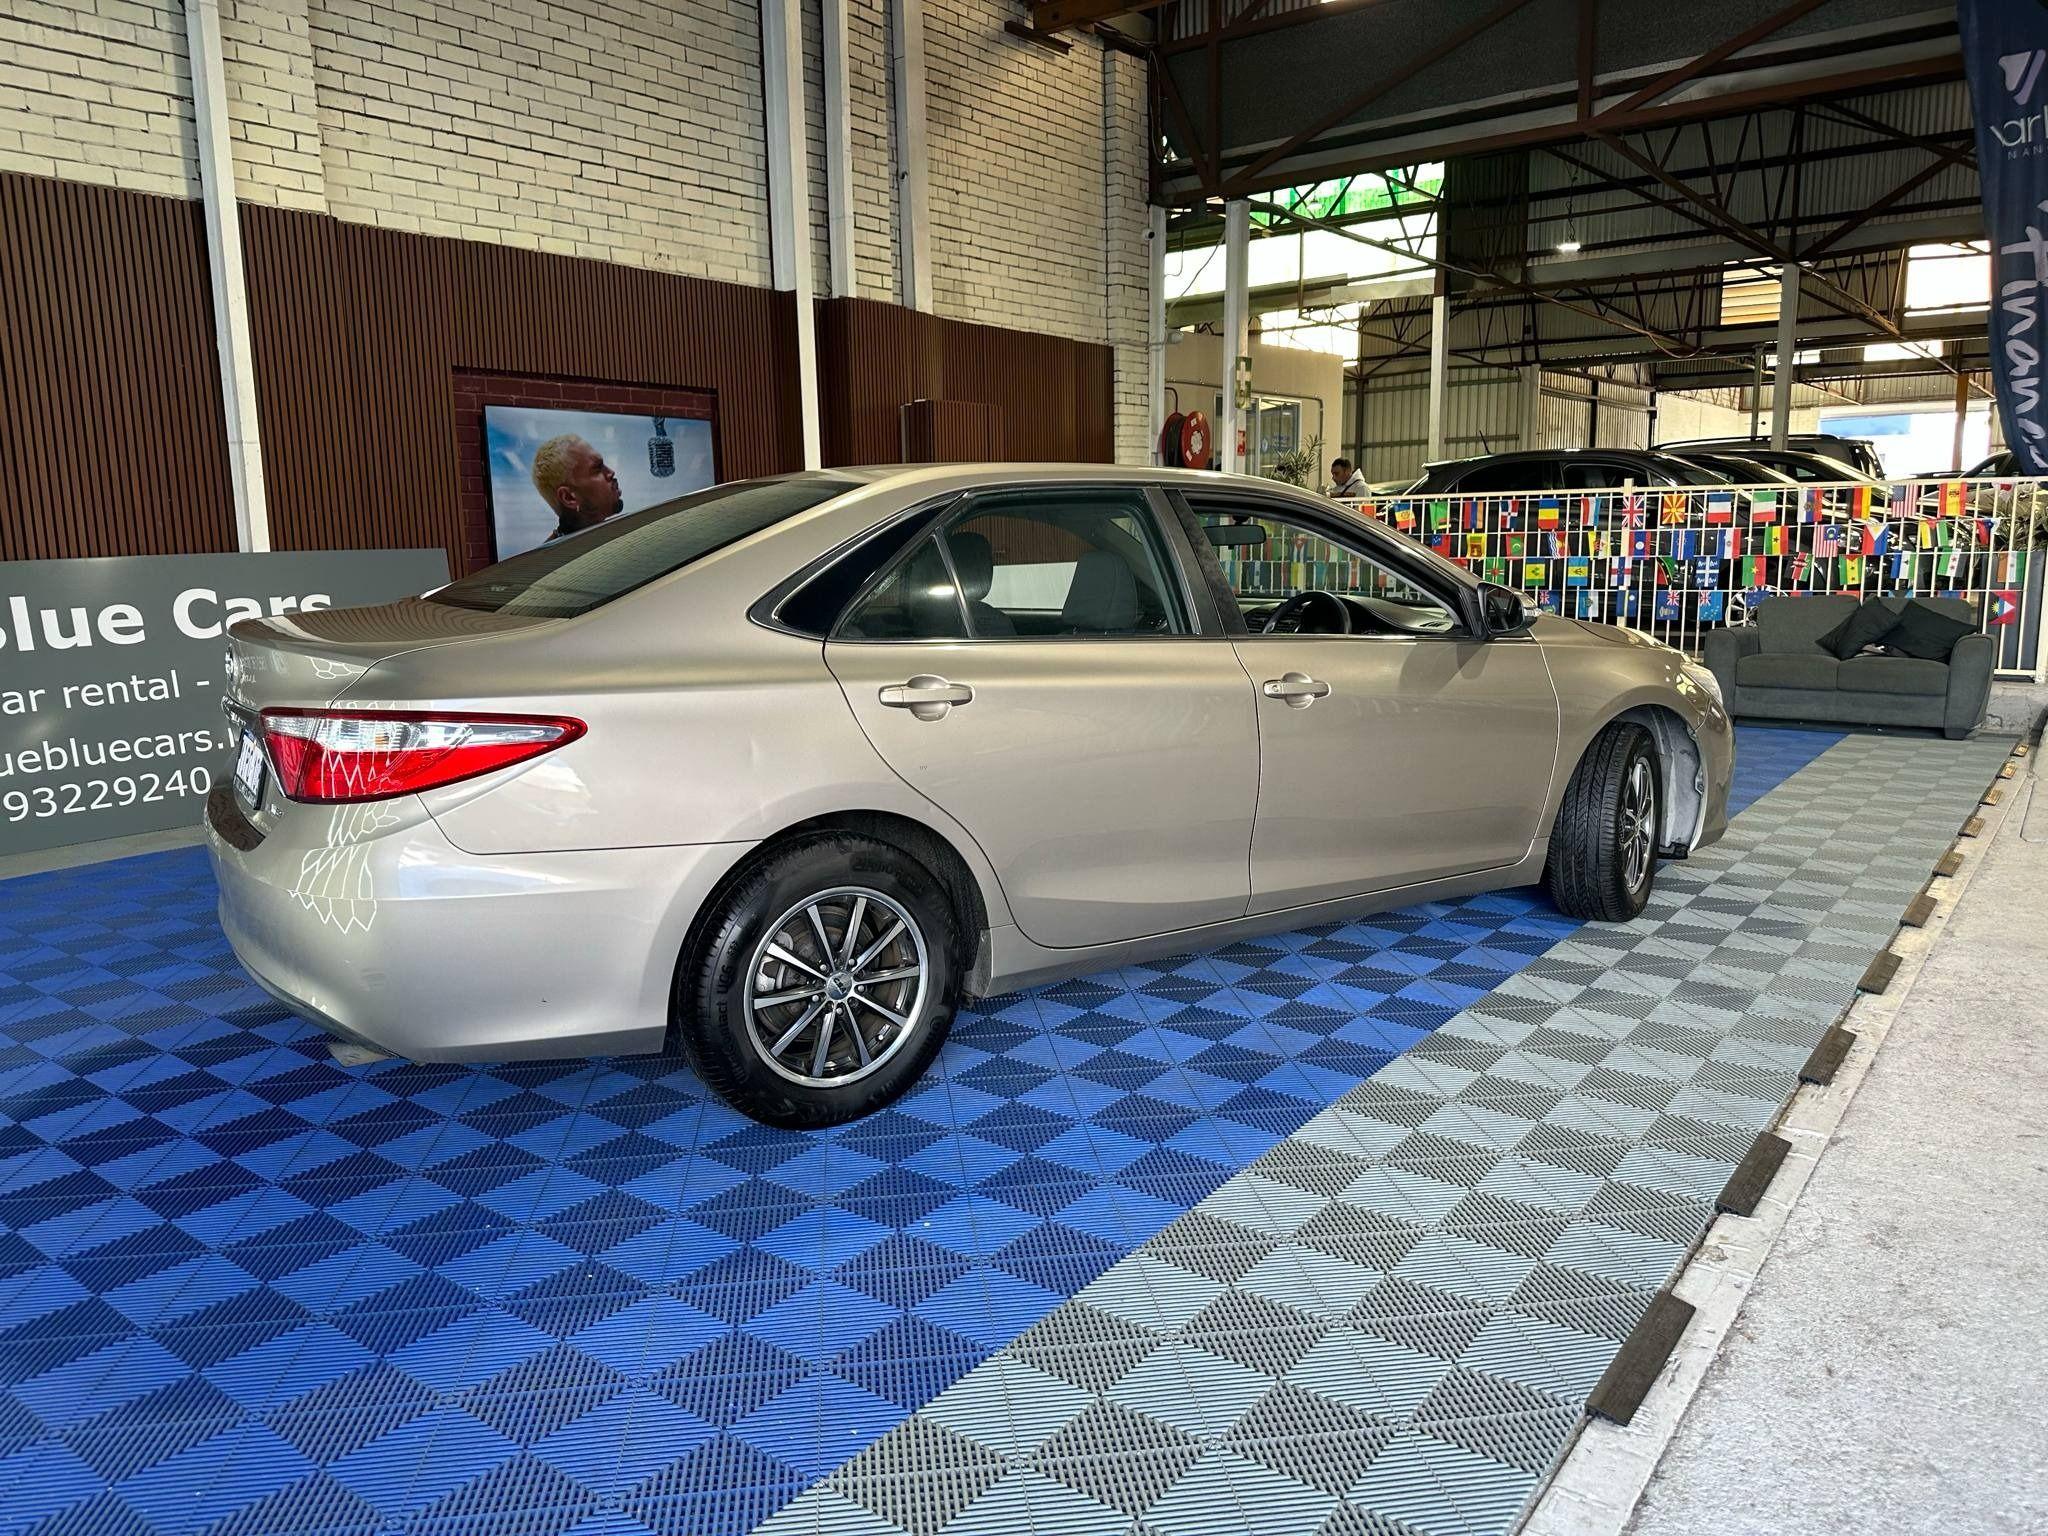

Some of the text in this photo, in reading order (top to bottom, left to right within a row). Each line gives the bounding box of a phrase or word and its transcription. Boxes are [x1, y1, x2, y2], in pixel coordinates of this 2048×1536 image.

[0, 596, 146, 652] lue
[62, 669, 181, 709] rental
[0, 727, 236, 777] uebluecars.
[3, 766, 212, 822] 93229240
